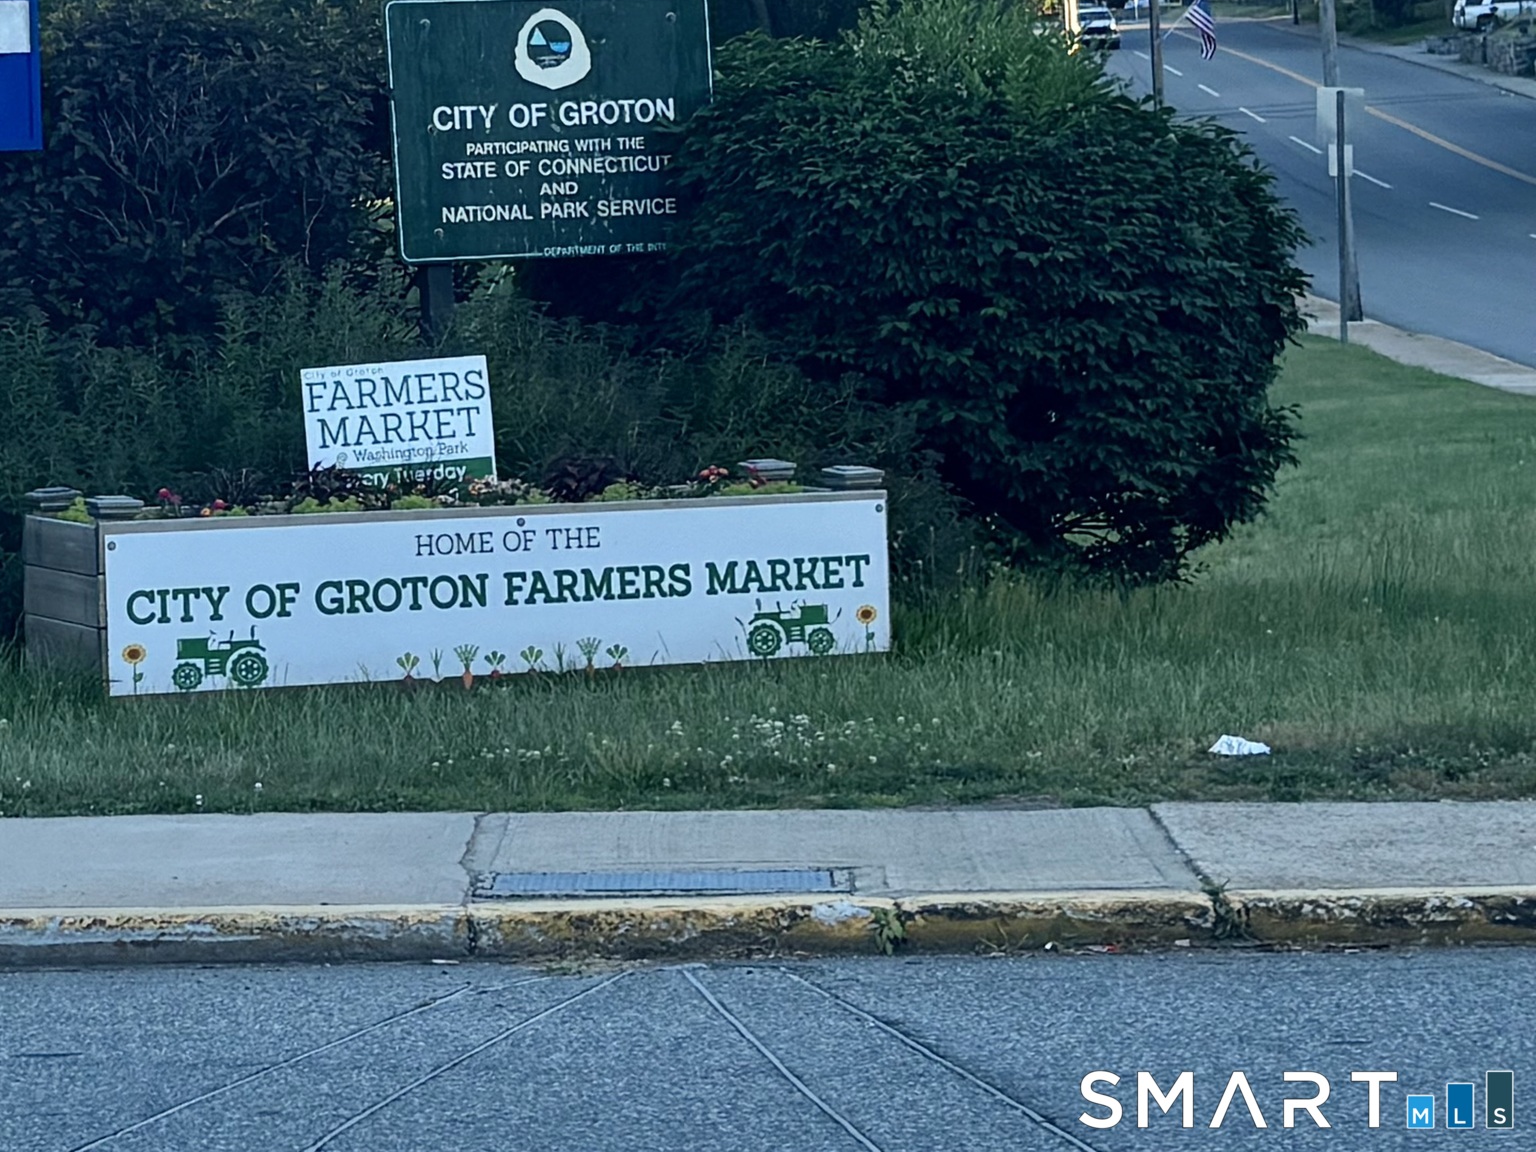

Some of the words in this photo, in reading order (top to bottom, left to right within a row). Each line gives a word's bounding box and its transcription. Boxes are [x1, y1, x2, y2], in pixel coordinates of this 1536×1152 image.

[432, 104, 495, 131] CITY
[509, 102, 547, 128] OF
[559, 97, 675, 125] GROTON
[466, 139, 569, 156] PARTICIPATING
[574, 137, 611, 153] WITH
[616, 136, 645, 150] THE
[441, 161, 497, 179] STATE
[505, 160, 531, 177] OF
[538, 155, 672, 176] CONNECTICUT
[539, 181, 579, 196] AND
[441, 204, 534, 223] NATIONAL
[540, 201, 589, 219] PARK
[596, 198, 677, 217] SERVICE
[609, 243, 622, 254] OF
[625, 242, 645, 253] THE
[305, 369, 486, 413] FARMERS
[316, 406, 480, 449] MARKET
[352, 445, 435, 463] Washington
[438, 440, 469, 456] Park
[415, 531, 494, 557] HOME
[502, 529, 536, 552] OF
[545, 526, 601, 551] THE
[126, 585, 230, 625] CITY
[245, 581, 300, 619] OF
[314, 572, 489, 617] GROTON
[503, 561, 693, 606] FARMERS
[705, 553, 871, 596] MARKET
